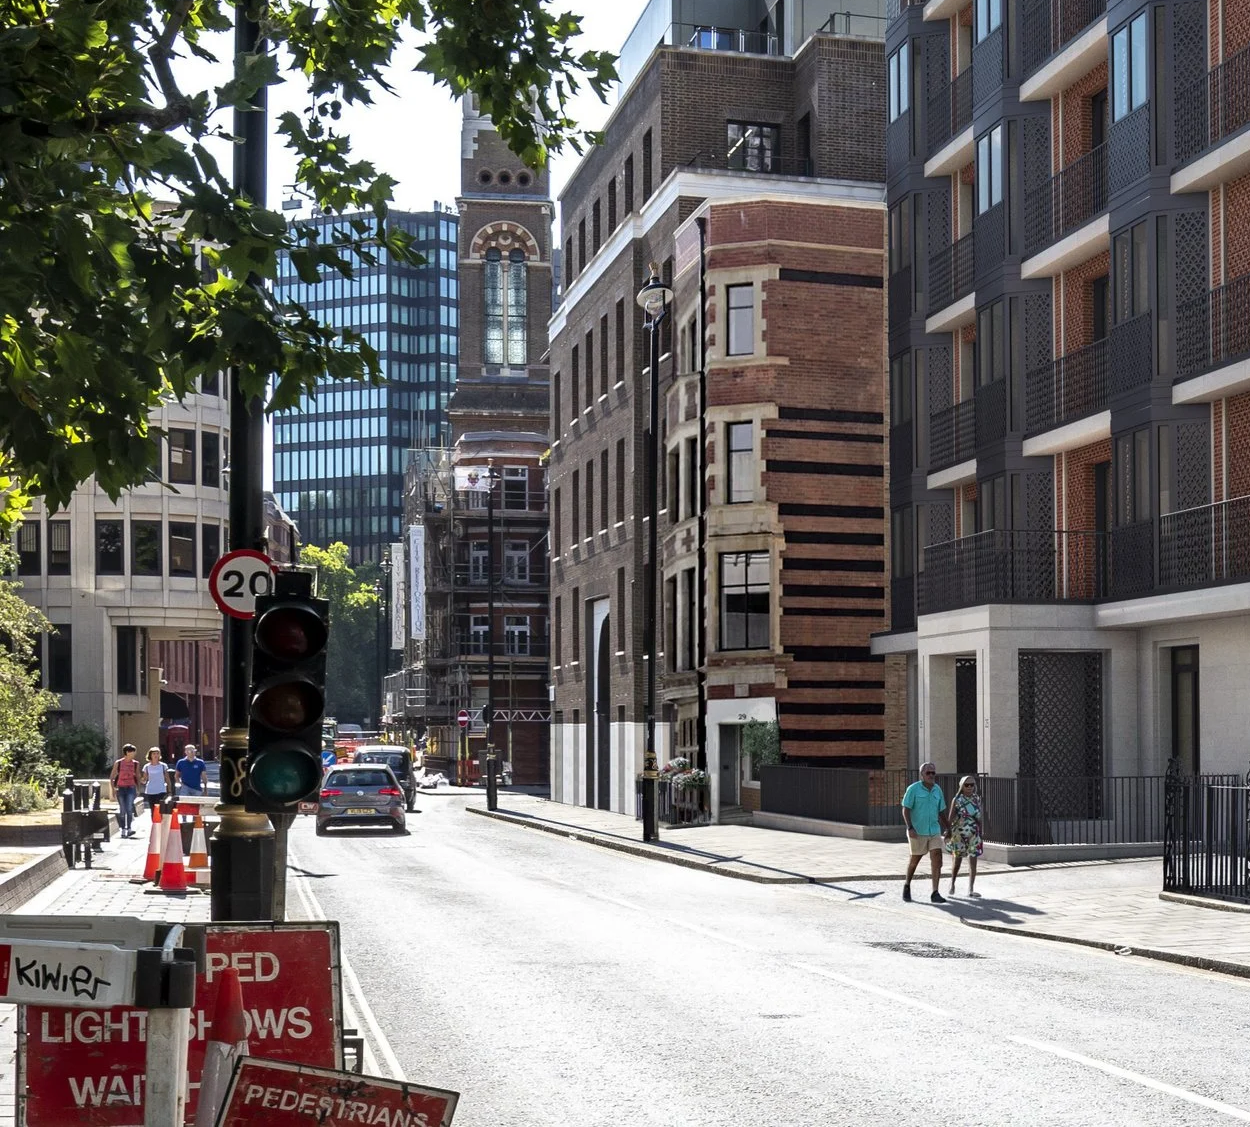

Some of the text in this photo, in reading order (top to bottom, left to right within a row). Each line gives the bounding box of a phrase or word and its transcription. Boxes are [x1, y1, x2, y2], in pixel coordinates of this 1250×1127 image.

[222, 570, 273, 598] 20
[738, 713, 747, 721] 29
[41, 1011, 149, 1044] LIGHT
[68, 1075, 147, 1107] WAI
[244, 1085, 429, 1127] PEDESTRIANS
